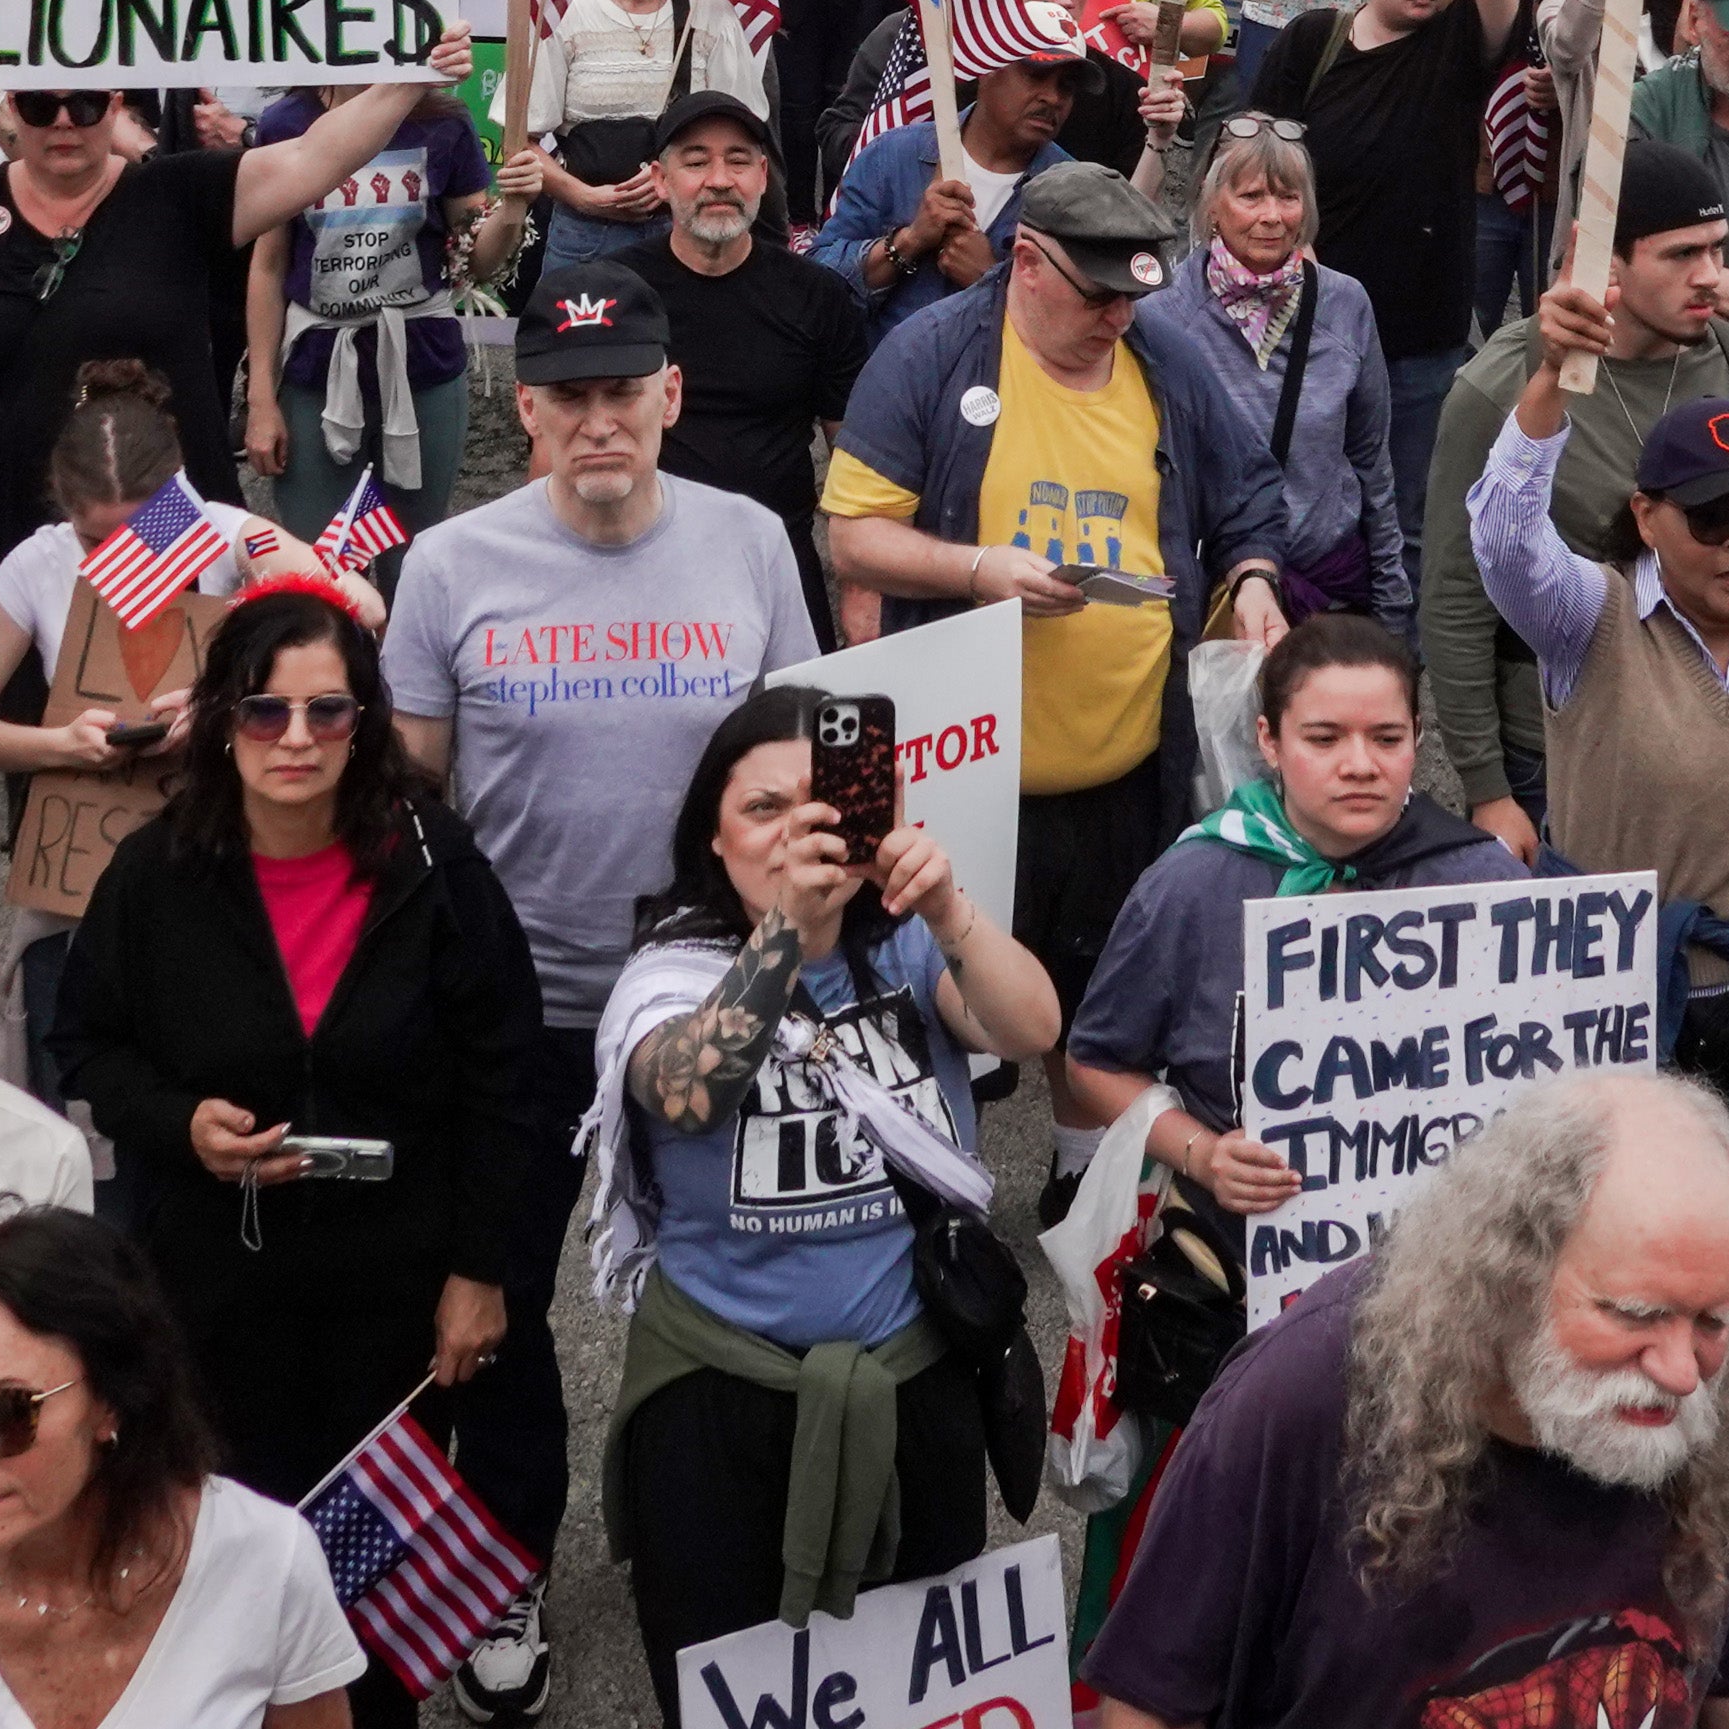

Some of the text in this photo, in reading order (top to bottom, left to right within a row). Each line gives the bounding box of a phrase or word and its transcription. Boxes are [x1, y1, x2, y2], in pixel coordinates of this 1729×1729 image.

[344, 231, 390, 252] STOP
[347, 274, 381, 294] OUR
[962, 392, 998, 416] HARRIS
[482, 622, 735, 669] LATE SHOW
[482, 664, 735, 716] stephen colbert
[1265, 888, 1654, 1011] FIRST THEY
[1251, 1001, 1650, 1111] CAME FOR THE
[731, 1210, 856, 1233] NO HUMAN
[1250, 1216, 1362, 1277] AND
[907, 1565, 1057, 1706] ALL
